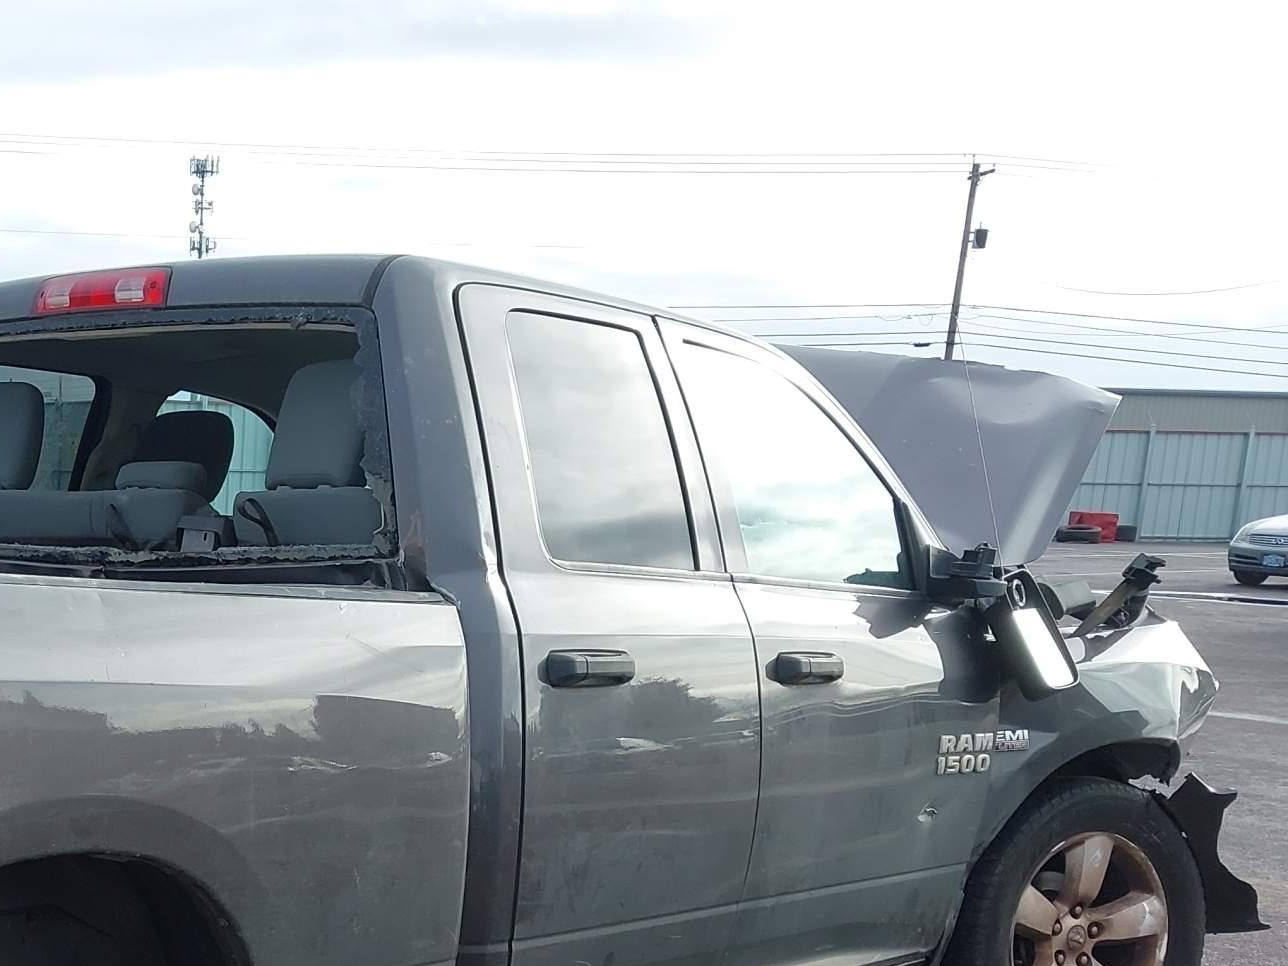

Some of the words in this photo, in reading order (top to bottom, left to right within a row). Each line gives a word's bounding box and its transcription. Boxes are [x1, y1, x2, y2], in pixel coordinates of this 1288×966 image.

[939, 732, 994, 754] RAM
[996, 729, 1029, 741] EMI
[937, 754, 991, 775] 1500
